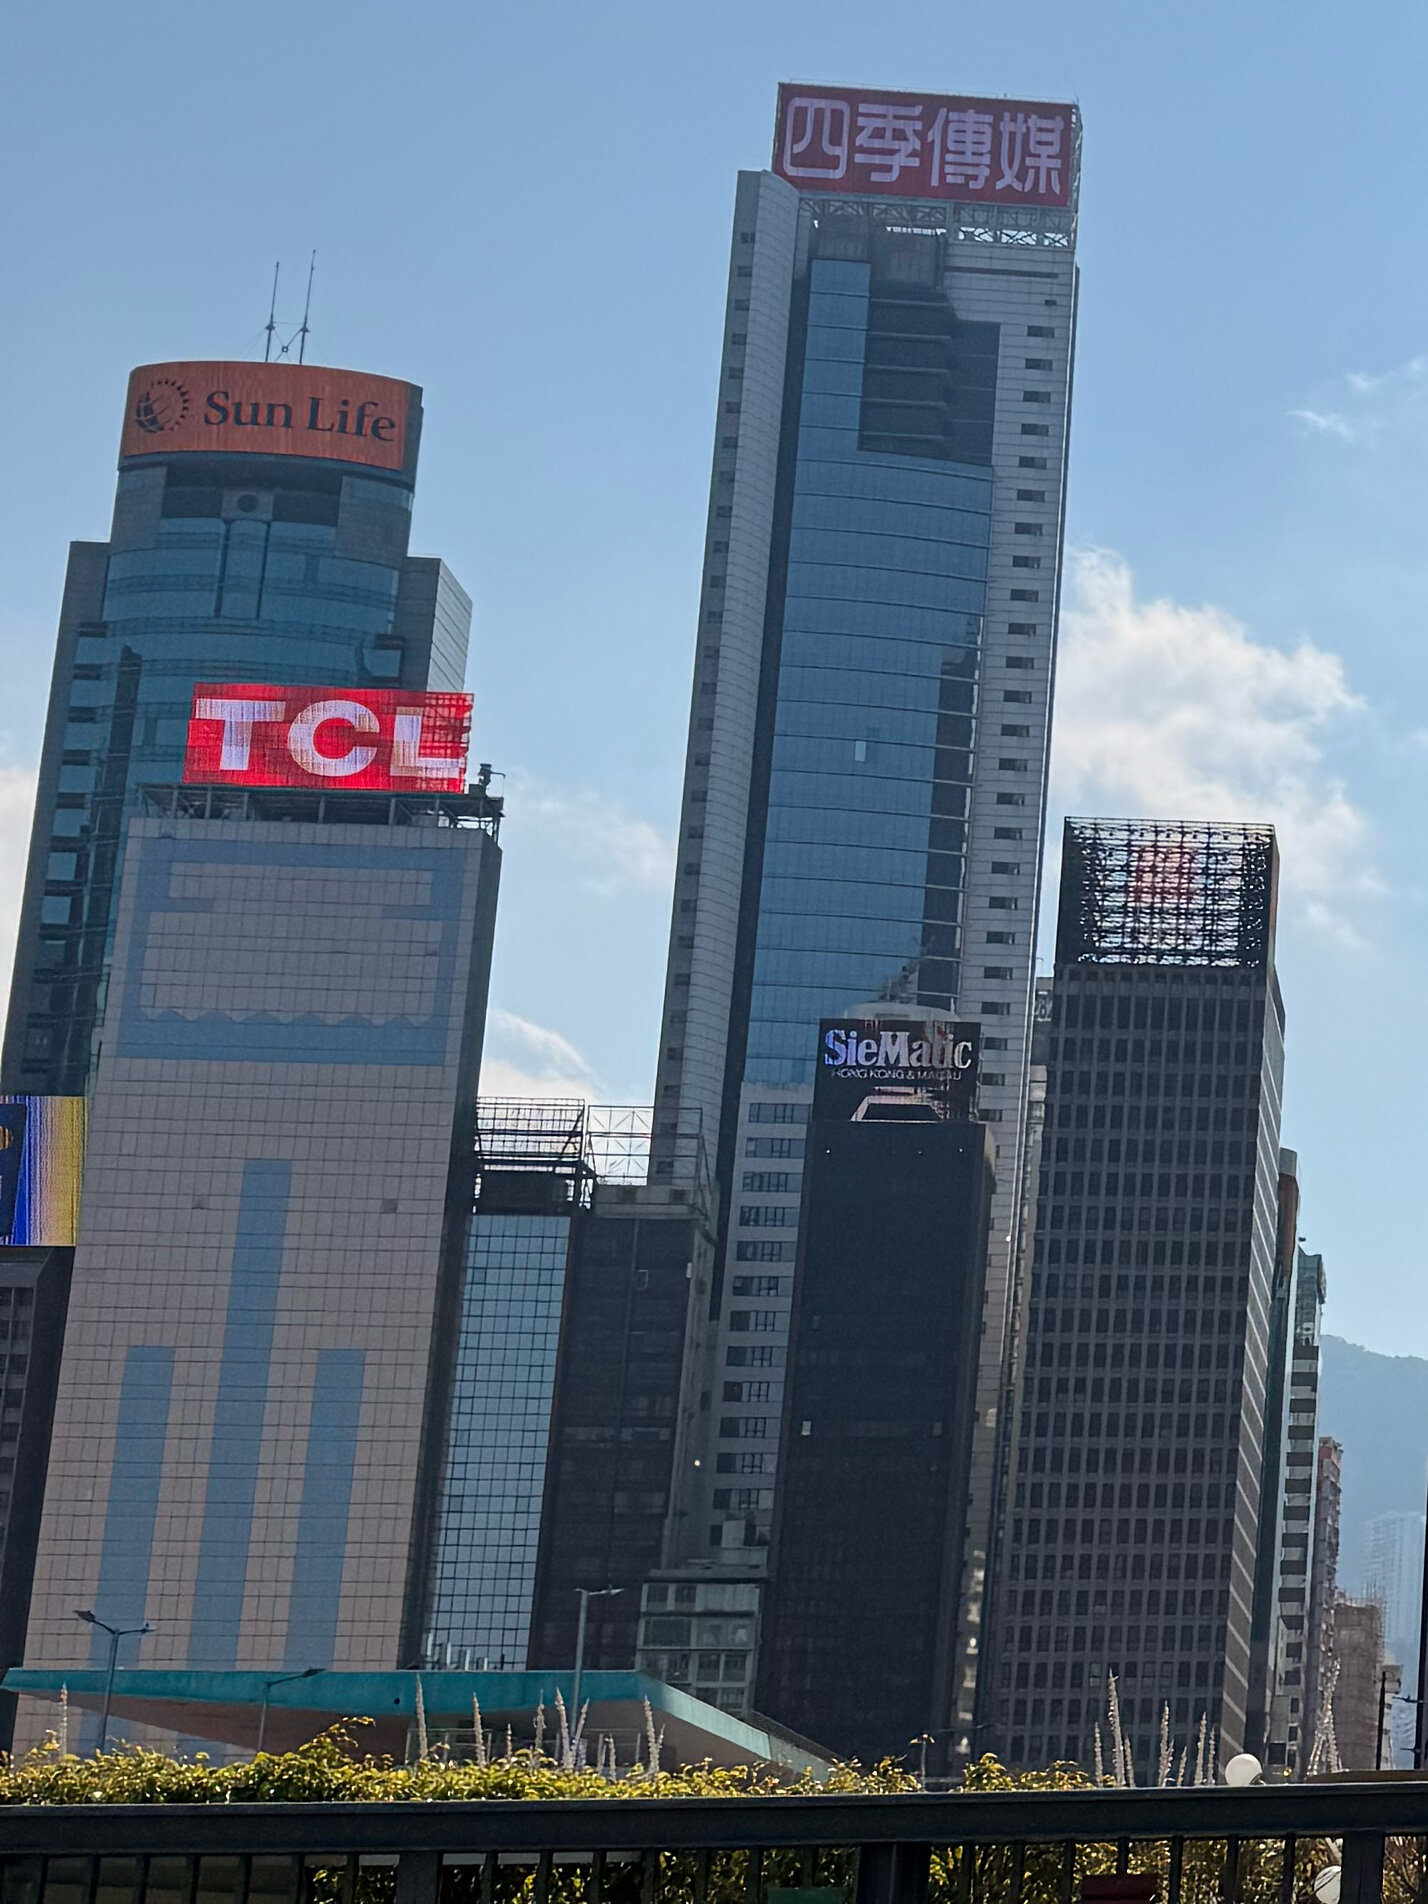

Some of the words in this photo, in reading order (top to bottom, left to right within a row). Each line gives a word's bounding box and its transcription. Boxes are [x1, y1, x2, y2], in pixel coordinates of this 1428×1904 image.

[784, 97, 1064, 195] 四季傳媒
[203, 389, 294, 429] Sun
[307, 395, 397, 444] Life
[195, 699, 467, 777] TCL
[825, 1029, 973, 1069] SieMatic
